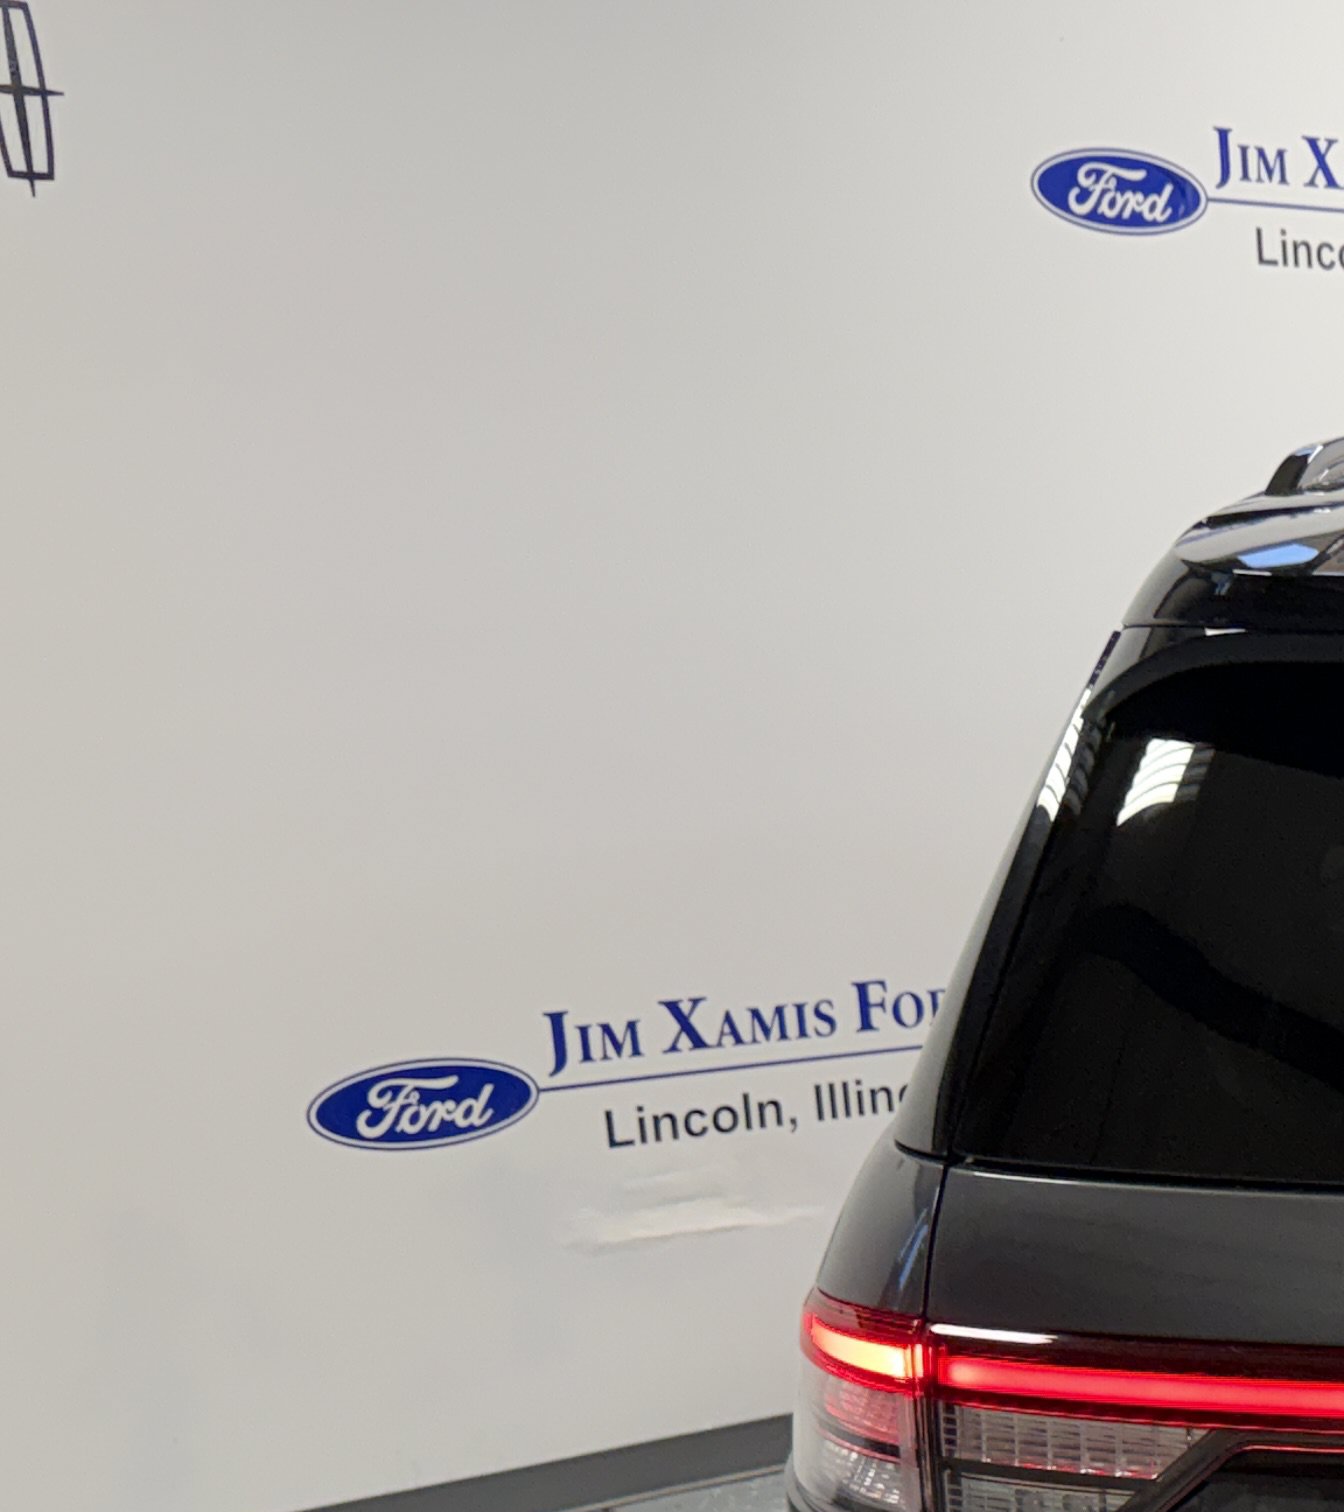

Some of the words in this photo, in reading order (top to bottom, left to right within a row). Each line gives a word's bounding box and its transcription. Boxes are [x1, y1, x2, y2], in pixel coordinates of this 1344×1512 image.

[1067, 160, 1174, 224] Ford
[355, 1074, 494, 1140] Ford
[605, 1093, 796, 1148] Lincoln,
[815, 1080, 906, 1121] Illin
